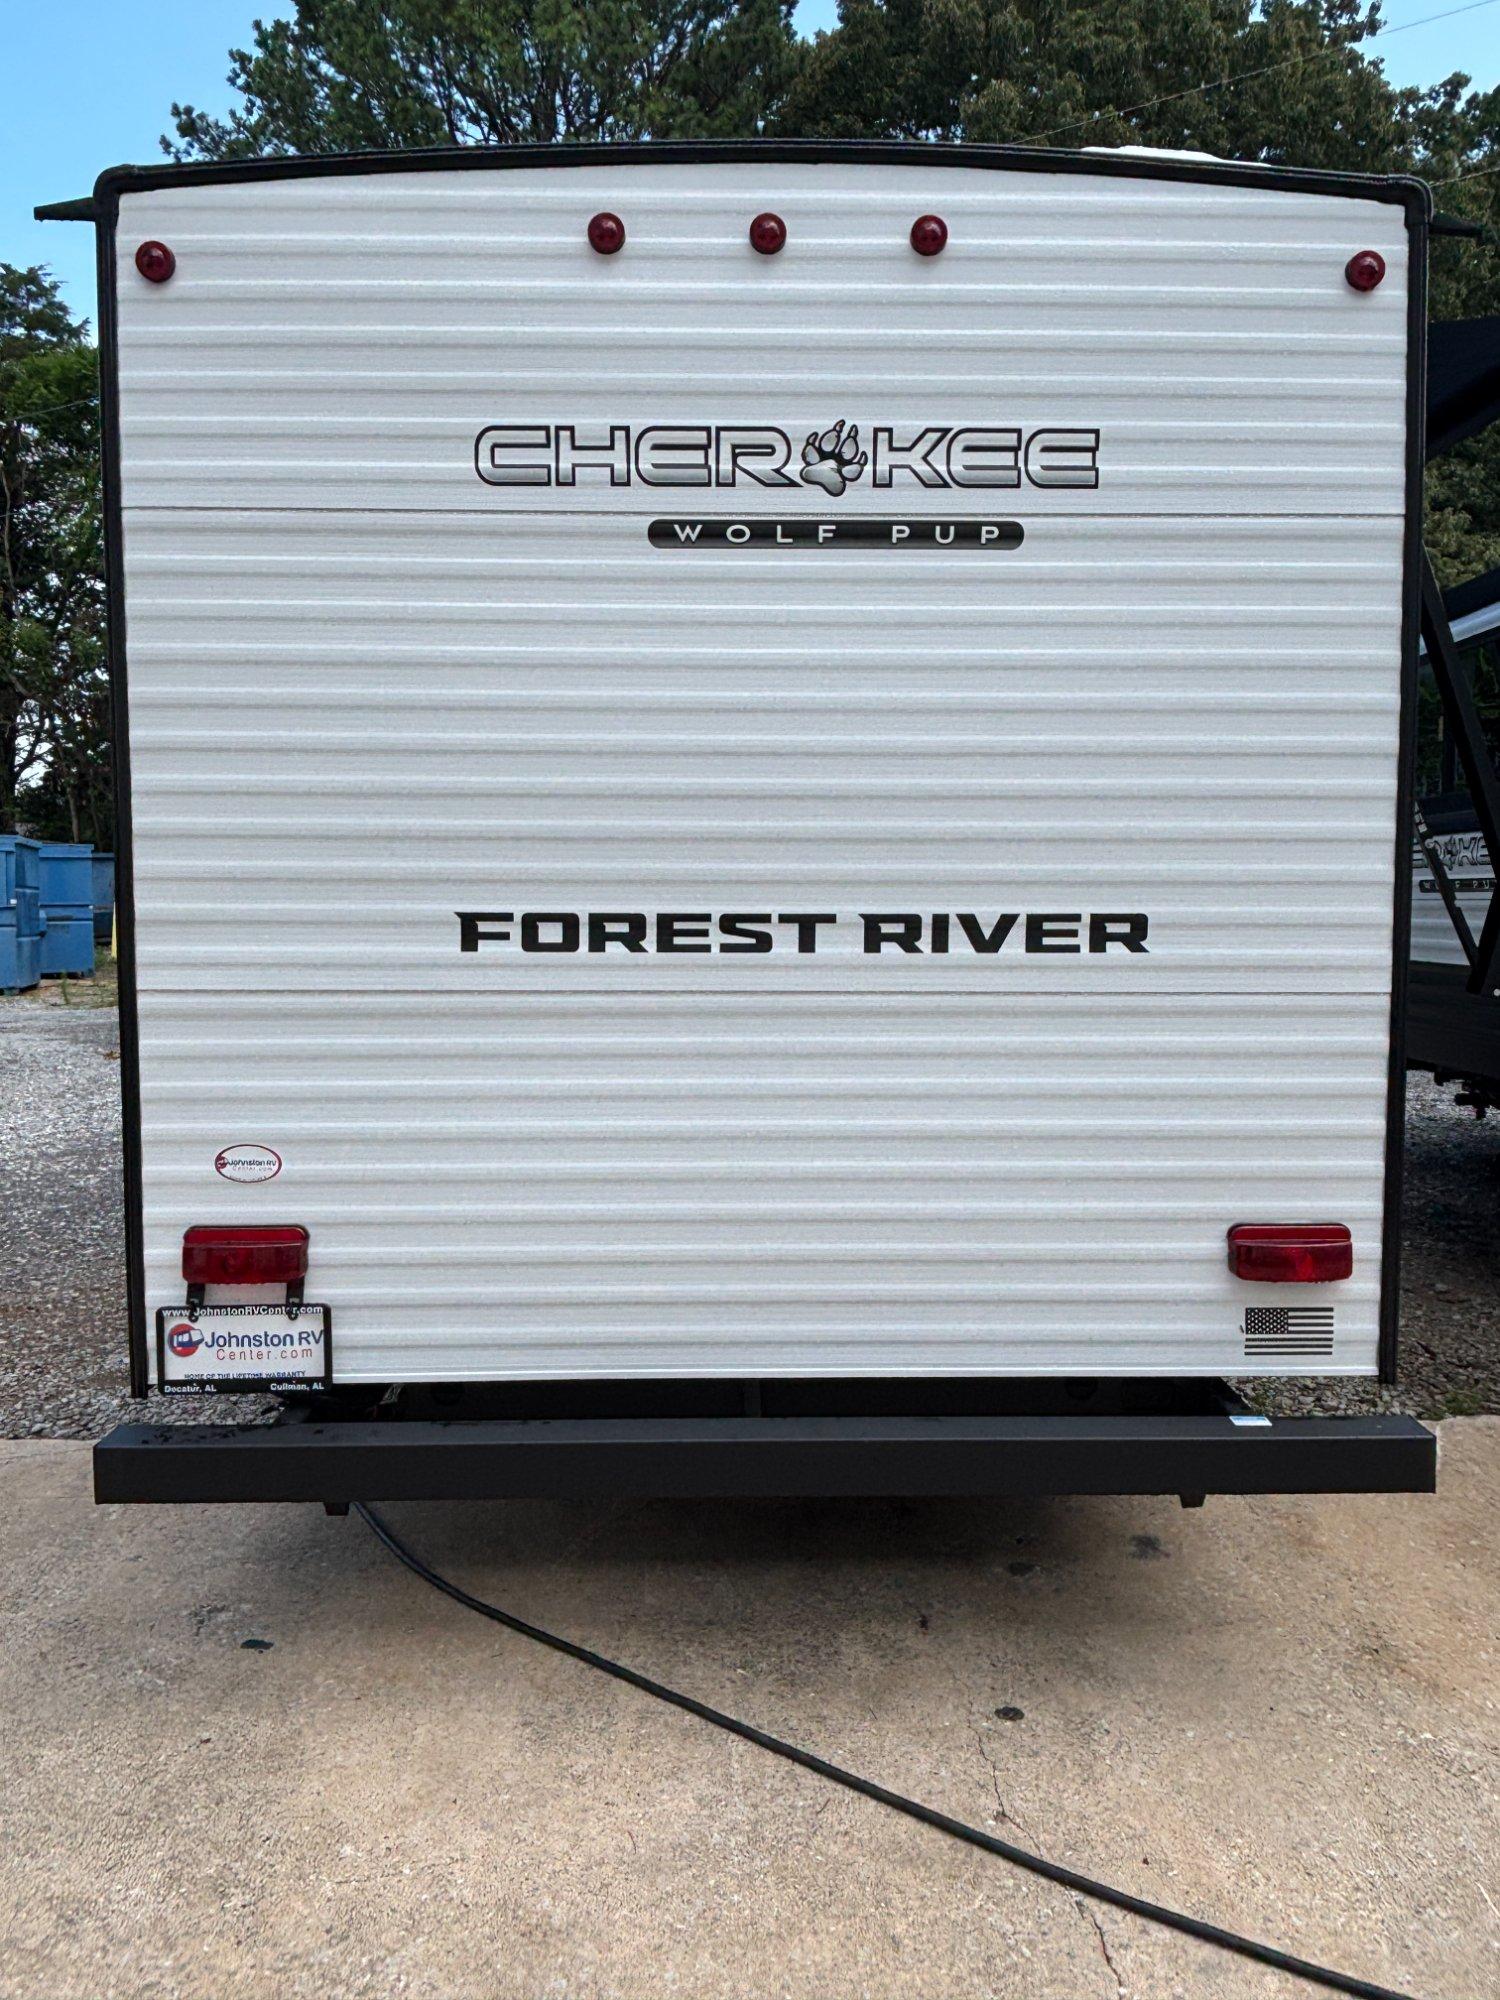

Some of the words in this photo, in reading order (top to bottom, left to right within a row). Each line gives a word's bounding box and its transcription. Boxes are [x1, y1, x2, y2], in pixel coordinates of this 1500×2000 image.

[673, 524, 836, 544] WOLF
[891, 525, 1000, 544] PUP
[454, 911, 837, 953] FOREST
[858, 912, 1150, 953] RIVER
[204, 1331, 294, 1348] Johnston
[298, 1330, 324, 1345] RV
[216, 1348, 313, 1361] Center.com
[265, 1370, 306, 1378] WARRANTY
[204, 1384, 217, 1392] AL
[312, 1382, 325, 1390] AL
